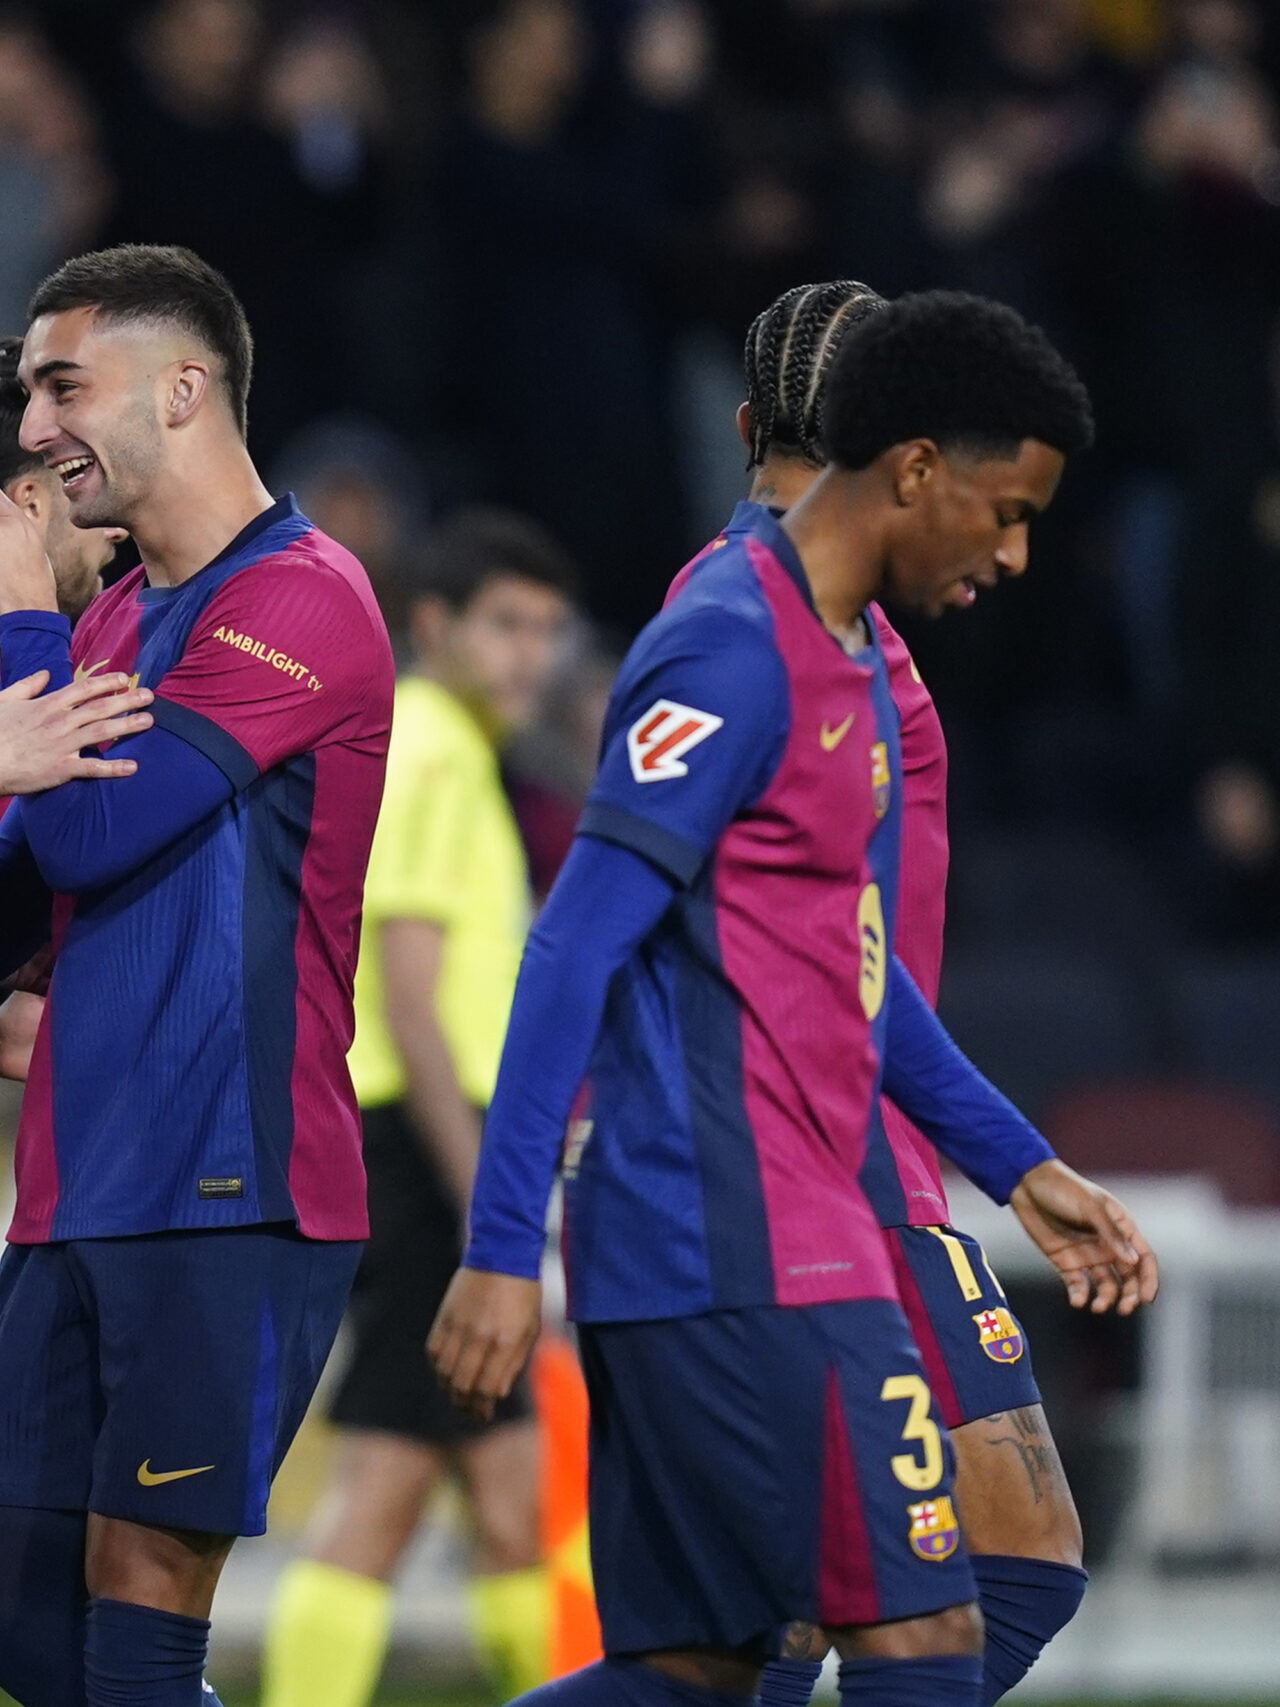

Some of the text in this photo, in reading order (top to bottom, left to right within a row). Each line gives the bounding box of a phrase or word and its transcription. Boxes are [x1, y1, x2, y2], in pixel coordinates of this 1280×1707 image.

[213, 625, 323, 692] AMBILIGHT tv
[881, 1375, 944, 1491] 3
